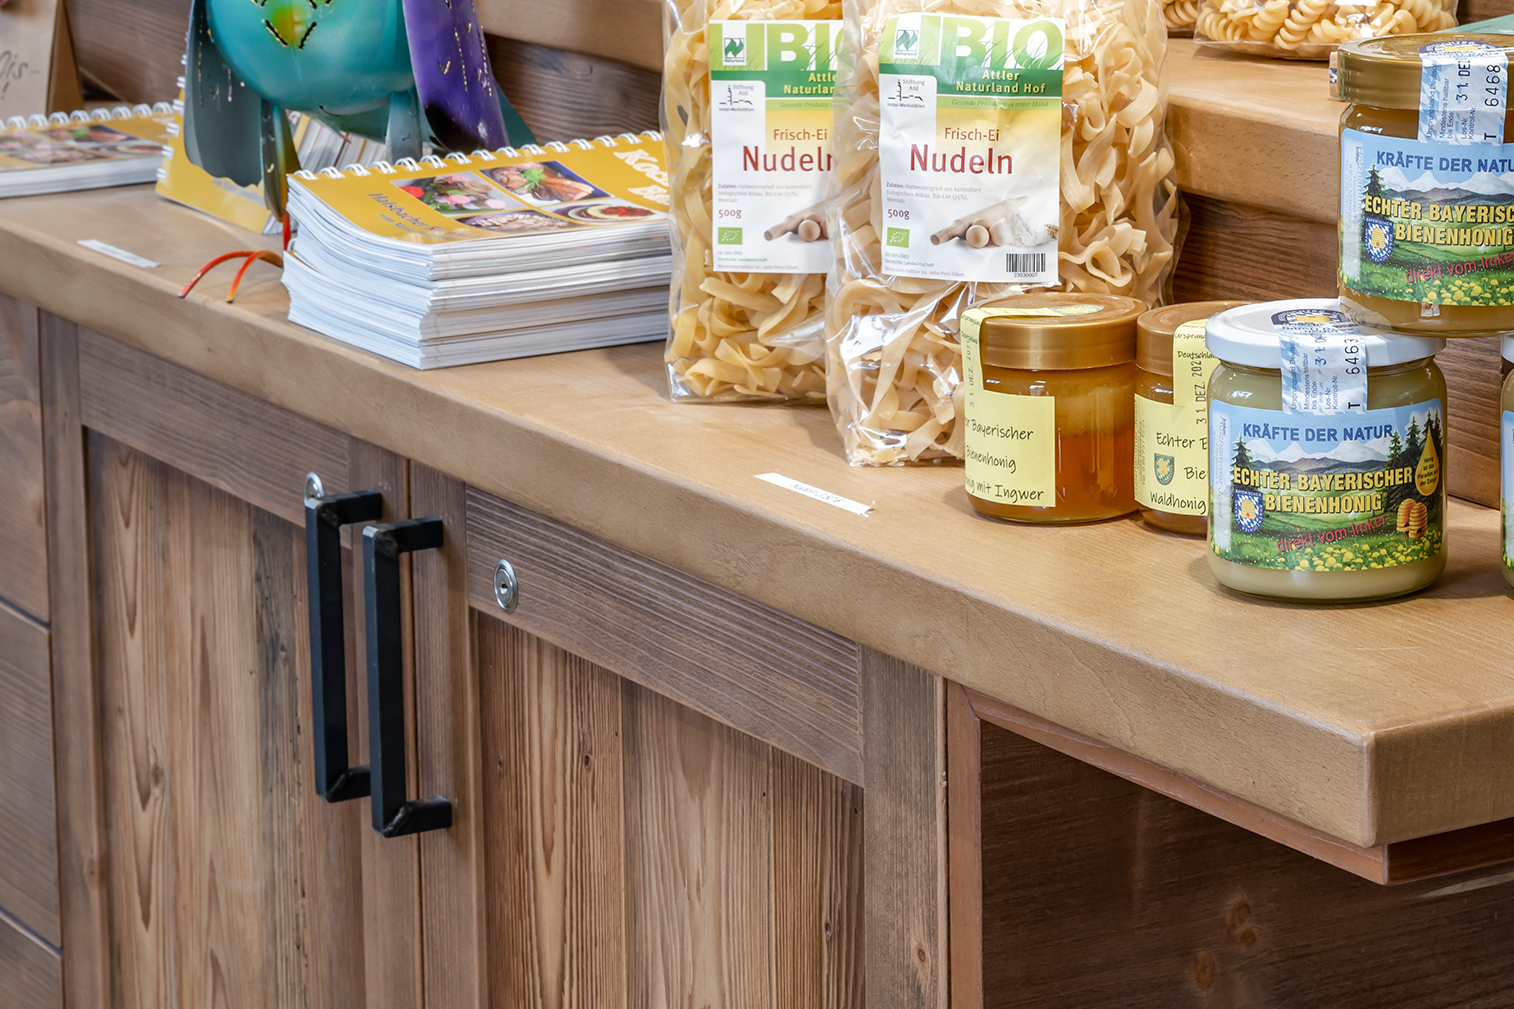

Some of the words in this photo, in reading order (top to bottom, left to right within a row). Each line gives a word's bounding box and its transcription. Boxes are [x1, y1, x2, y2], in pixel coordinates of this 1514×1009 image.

[943, 17, 1063, 71] BIO
[982, 70, 1020, 81] Attler
[1484, 64, 1502, 108] 6468
[956, 81, 1018, 94] Naturland
[1023, 83, 1046, 94] Hof
[1032, 100, 1049, 108] Hand
[1439, 103, 1447, 139] Mindestens
[1468, 106, 1477, 140] Kontroll-Nr.
[773, 128, 828, 141] Frisch-Ei
[944, 127, 999, 142] Frisch-Ei
[1484, 132, 1497, 140] T
[910, 144, 1013, 175] Nudeln
[1376, 150, 1434, 171] KRÄFTE
[1439, 157, 1472, 172] DER
[718, 208, 742, 220] 500g
[887, 208, 910, 220] 500g
[1364, 194, 1422, 220] ECHTER
[1405, 265, 1443, 283] direkt
[1446, 260, 1477, 277] vom
[1344, 337, 1361, 376] 6463
[1348, 401, 1361, 410] T
[972, 418, 1034, 441] Bayerischer
[1156, 432, 1195, 449] Echter
[1243, 423, 1300, 441] KRÄFTE
[1304, 428, 1338, 442] DER
[1343, 424, 1394, 441] NATUR
[1233, 466, 1291, 490] ECHTER
[1297, 467, 1413, 492] BAYERISCHER
[976, 481, 991, 495] mit
[994, 484, 1044, 504] Ingwer
[1149, 491, 1207, 515] Waldhonig
[1277, 534, 1313, 553] direkt
[1317, 528, 1348, 545] vom
[1351, 514, 1387, 535] Imker
